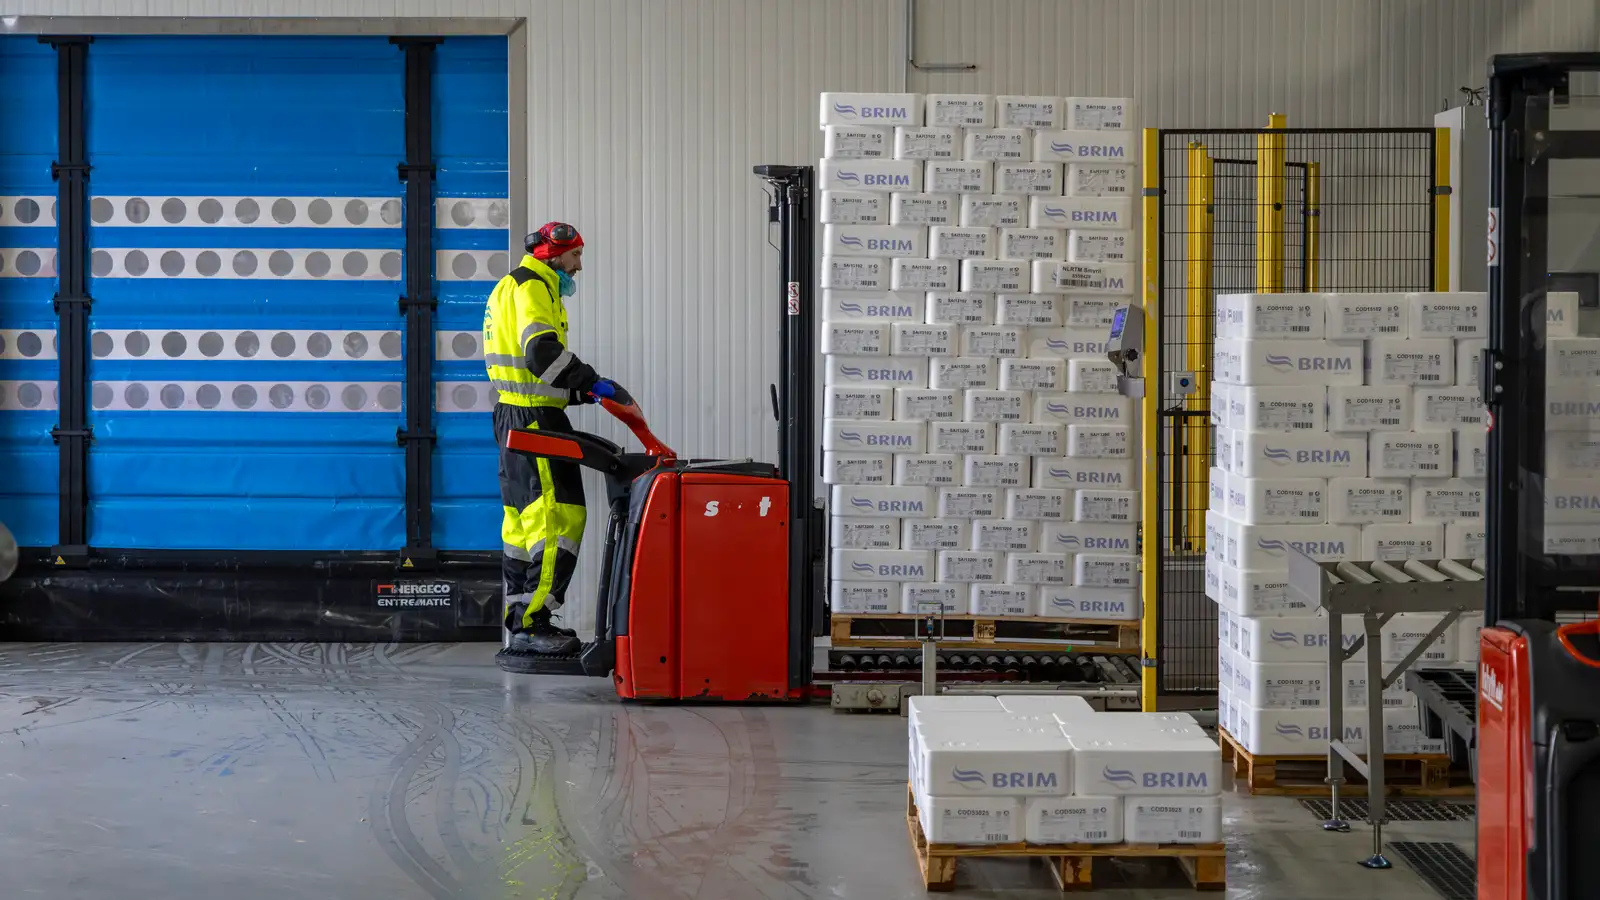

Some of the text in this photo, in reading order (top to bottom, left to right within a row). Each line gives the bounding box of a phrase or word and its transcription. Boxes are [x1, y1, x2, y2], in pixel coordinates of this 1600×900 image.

[861, 107, 907, 118] BRIM
[1078, 145, 1124, 157] BRIM
[864, 174, 910, 186] BRIM
[1071, 211, 1118, 222] BRIM
[867, 239, 913, 250] BRIM
[866, 305, 913, 317] BRIM
[1073, 342, 1110, 353] BRI
[1298, 357, 1352, 371] BRIM
[867, 369, 913, 381] BRIM
[1074, 406, 1119, 418] BRIM
[866, 434, 912, 446] BRIM
[1296, 450, 1351, 463] BRIM
[1076, 471, 1122, 483] BRIM
[878, 500, 924, 512] BRIM
[1555, 496, 1600, 509] BRI
[1084, 537, 1130, 549] BRIM
[878, 564, 924, 576] BRIM
[1079, 601, 1125, 612] BRIM
[1303, 634, 1356, 647] BRM
[992, 772, 1057, 788] BRIM
[1142, 771, 1208, 788] BRIM
